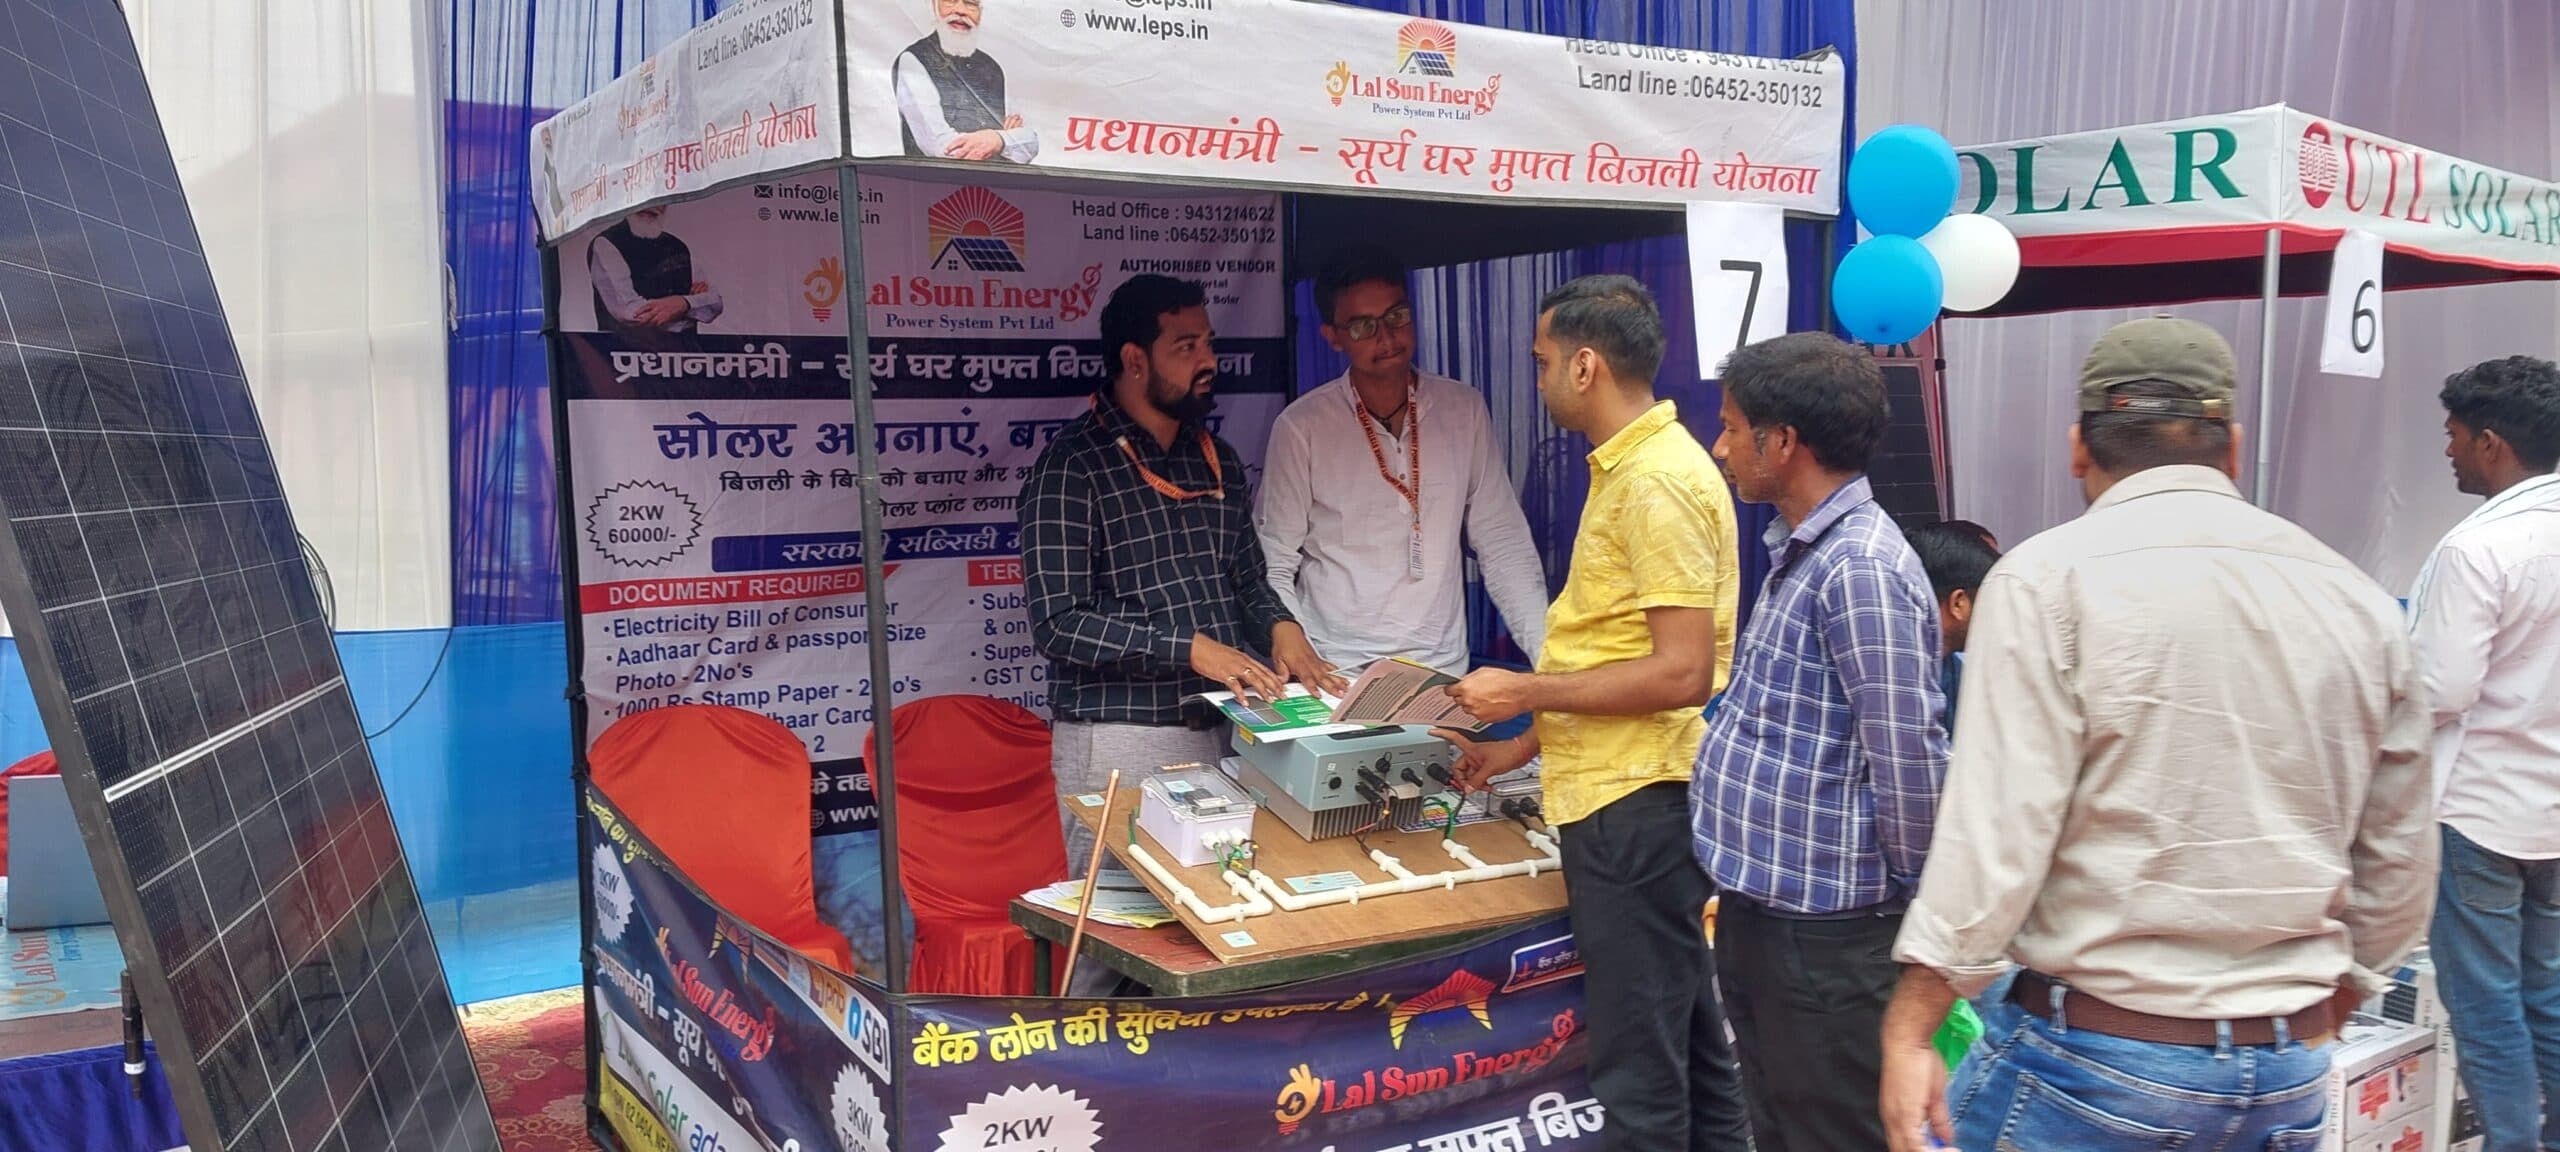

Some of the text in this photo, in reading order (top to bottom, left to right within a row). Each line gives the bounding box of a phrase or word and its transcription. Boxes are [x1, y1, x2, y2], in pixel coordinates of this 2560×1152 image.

[1085, 12, 1209, 41] www.leps.in
[697, 44, 719, 71] Land
[721, 35, 739, 61] line
[1352, 73, 1502, 116] Lal Sun Energy
[1577, 65, 1823, 108] Land line :06452-350132
[1373, 102, 1471, 121] Power System Pvt Ltd
[703, 109, 752, 171] बिजली
[756, 101, 817, 149] योजना
[1063, 115, 1284, 163] प्रधानमंत्री
[1338, 129, 1416, 184] सूर्य
[1424, 144, 1477, 176] घर
[1488, 149, 1576, 193] मुफ्त
[1586, 142, 1703, 190] बिजली
[1712, 152, 1821, 195] योजना
[1949, 126, 2249, 217] OLAR
[778, 183, 884, 204] info@les.in
[2343, 134, 2432, 224] UTL
[779, 206, 881, 226] www.le.in
[1072, 200, 1115, 218] Head
[1121, 202, 1169, 220] Office
[1184, 204, 1275, 222] 9431214622
[1083, 223, 1124, 241] Land
[1130, 225, 1160, 242] line
[1119, 258, 1276, 273] AUTHORISED VENDOR
[865, 263, 1103, 323] al Sun Energy
[1720, 259, 1763, 351] 7
[886, 312, 1054, 332] Power System Pvt Ltd
[2351, 279, 2377, 354] 6
[610, 342, 791, 383] प्रधानमंत्री
[905, 353, 956, 380] घर
[961, 353, 1040, 391] मुफ्त
[653, 411, 797, 460] सोलर
[719, 468, 794, 493] बिजली
[801, 469, 823, 490] के
[880, 467, 907, 487] को
[914, 470, 969, 486] बचाए
[974, 465, 1008, 483] और
[618, 504, 664, 522] 2KW
[608, 526, 677, 545] 60000/-
[898, 525, 1000, 555] सब्सिडी
[608, 571, 860, 606] DOCUMENT REQUIRED
[980, 561, 1022, 582] TER
[613, 612, 720, 639] Electricity
[726, 609, 762, 629] Bill
[767, 607, 790, 627] of
[984, 619, 997, 636] &
[616, 624, 927, 667] Aadhaar Card & passpor Size
[615, 671, 676, 694] Photo
[694, 662, 753, 684] 2No's
[701, 689, 770, 708] Stamp
[777, 683, 839, 705] Paper
[858, 676, 922, 696] 2o's
[983, 666, 1024, 686] GST
[862, 1009, 890, 1071] SBI
[912, 1021, 981, 1068] बैंक
[986, 1011, 1058, 1062] लोन
[1062, 1007, 1110, 1048] की
[1320, 1008, 1577, 1115] Lal Sun Energy
[847, 1097, 873, 1140] 3KW
[983, 1115, 1054, 1149] 2KW
